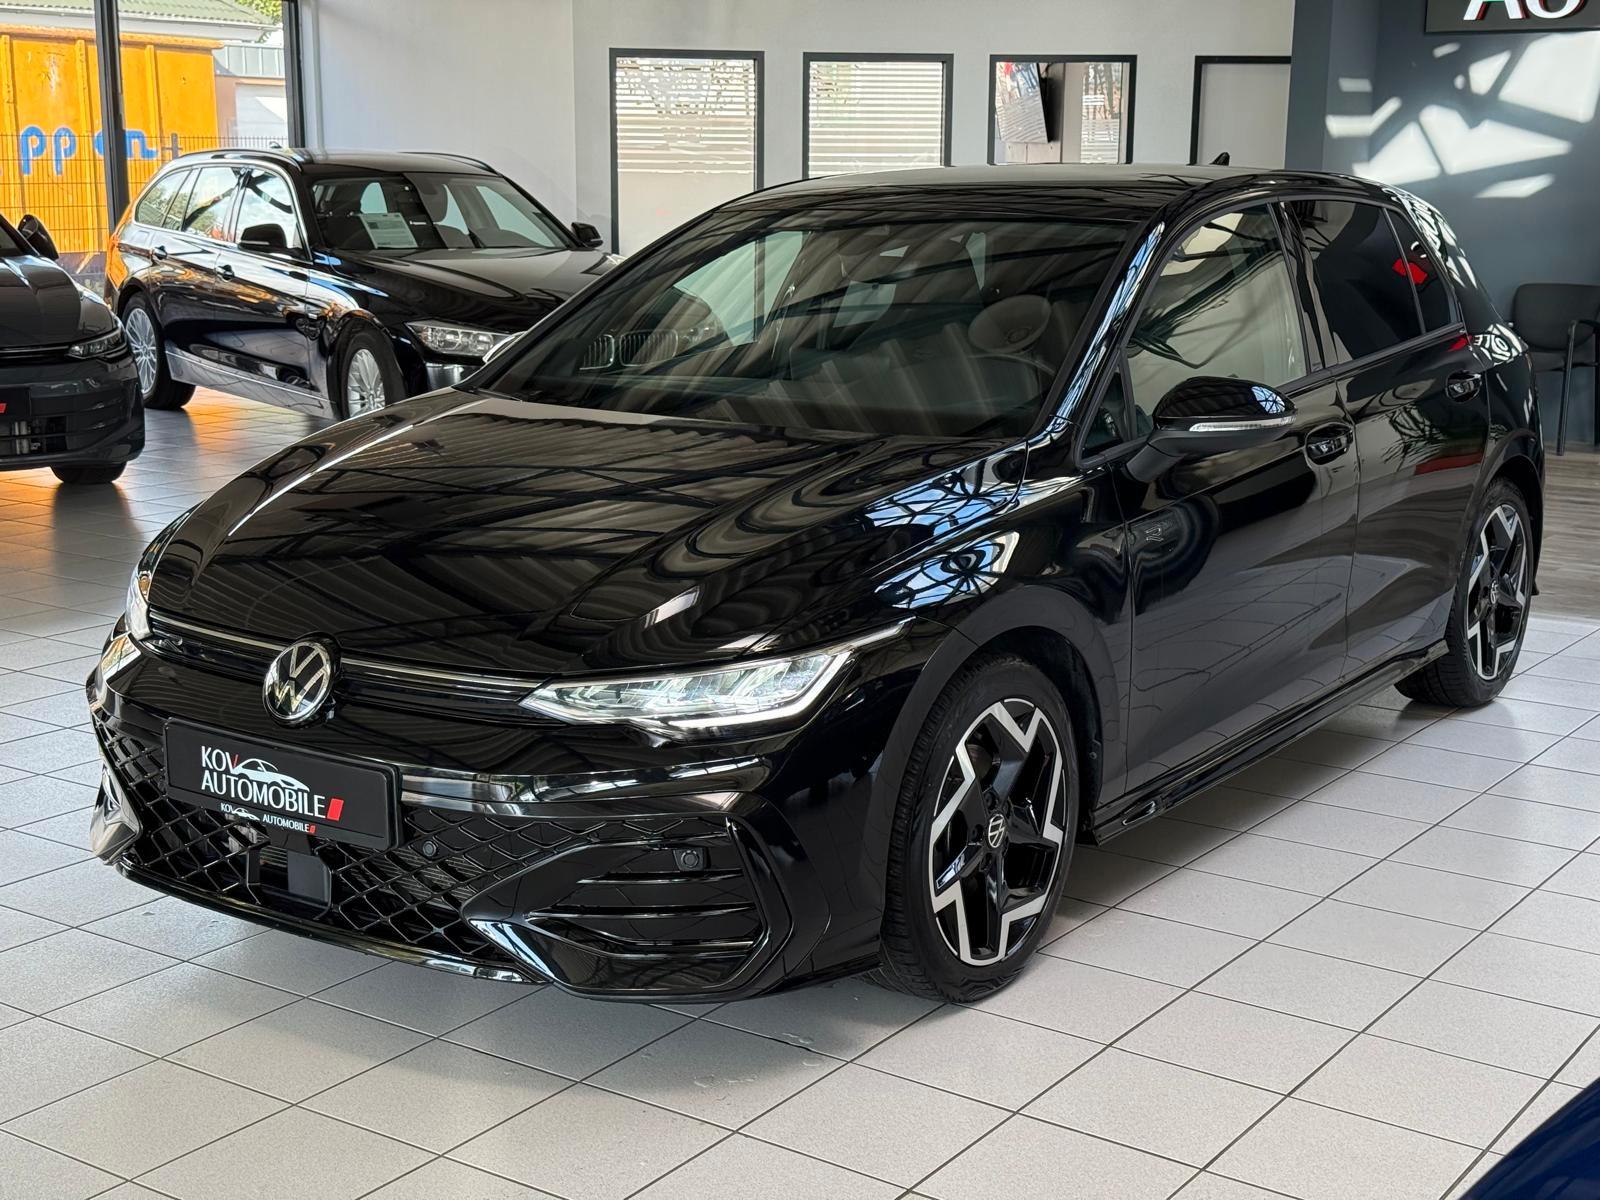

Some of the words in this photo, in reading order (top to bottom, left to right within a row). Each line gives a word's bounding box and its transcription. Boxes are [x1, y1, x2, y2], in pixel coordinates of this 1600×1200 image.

[201, 745, 239, 774] KOV
[201, 769, 327, 819] AUTOMOBILE
[262, 813, 310, 833] AUTOMOBILE
